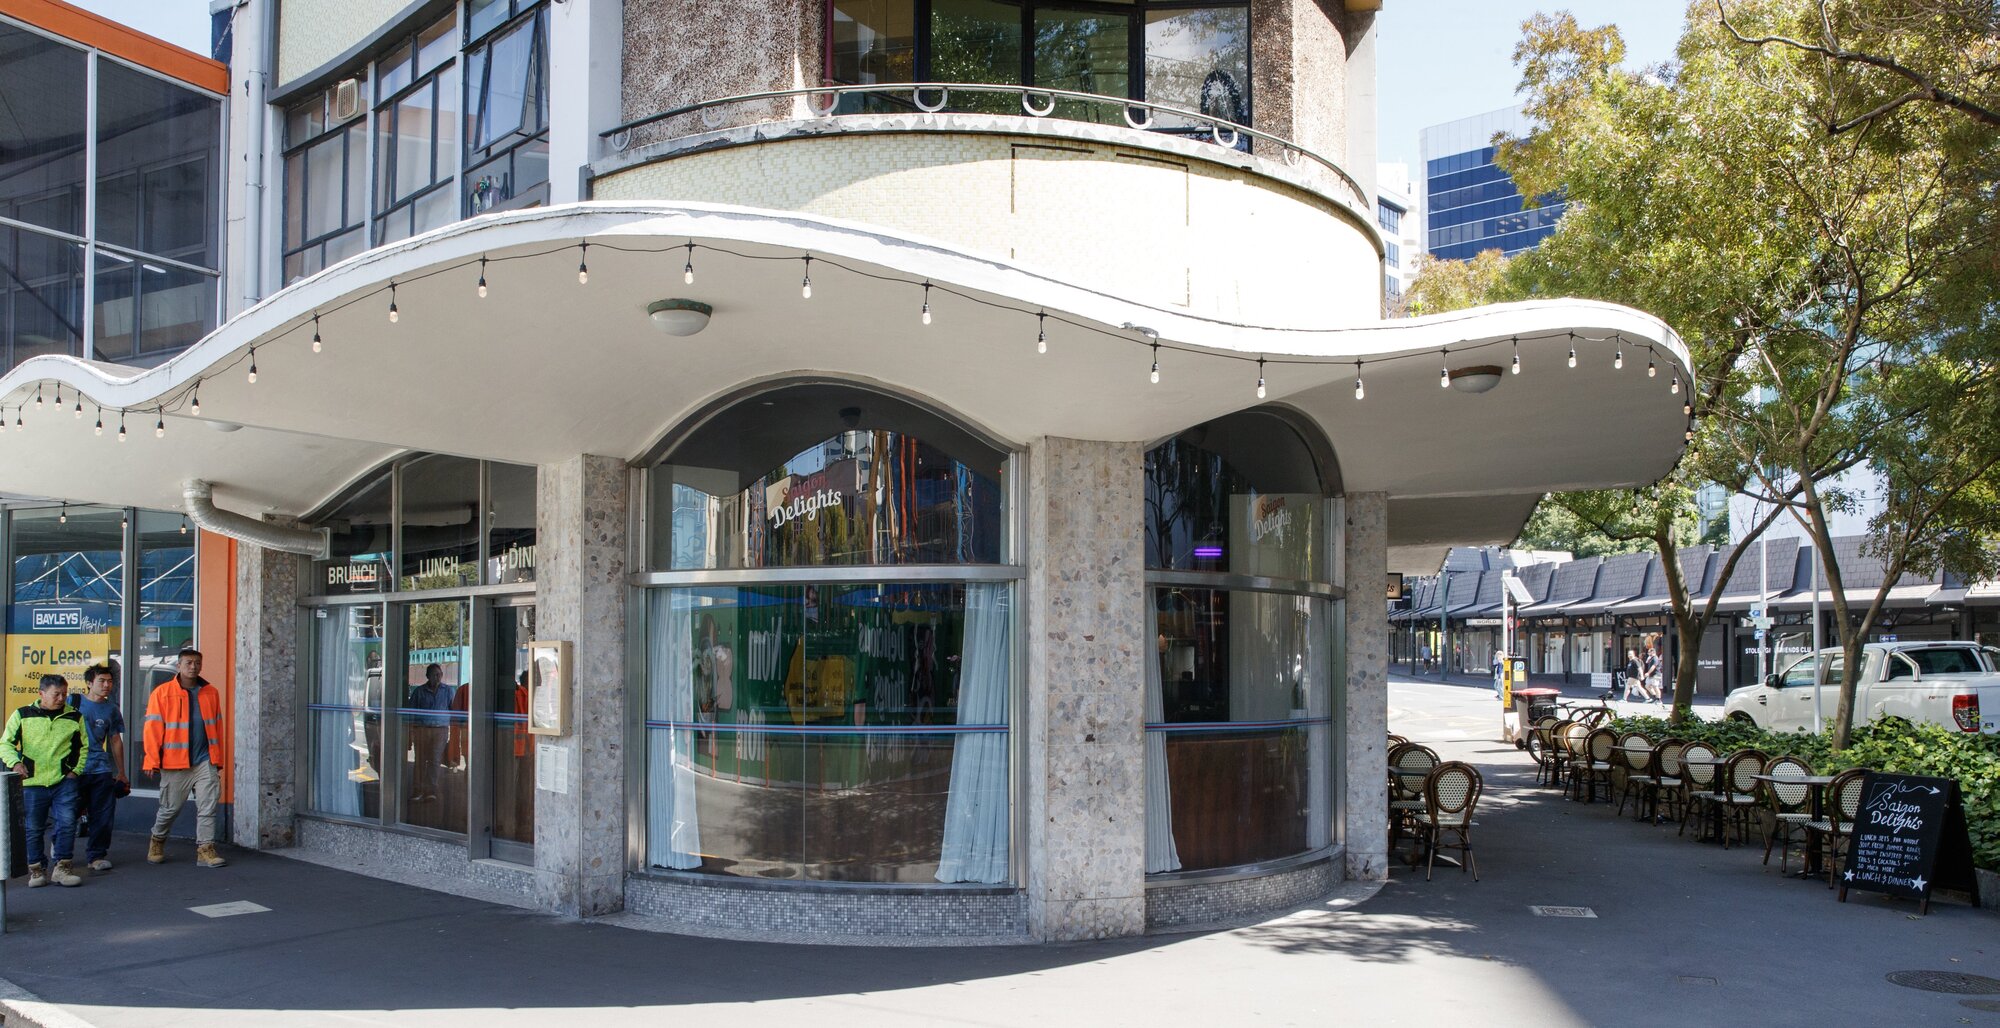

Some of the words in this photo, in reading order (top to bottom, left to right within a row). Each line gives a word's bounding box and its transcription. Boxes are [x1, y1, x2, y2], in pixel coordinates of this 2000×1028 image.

[773, 489, 841, 529] Delights
[1261, 496, 1285, 518] Saigon
[1255, 508, 1292, 541] Delights
[328, 564, 377, 584] BRUNCH
[420, 556, 459, 578] LUNCH
[35, 612, 79, 625] BAYLEYS
[22, 646, 46, 665] For
[50, 646, 92, 665] Lease
[1879, 793, 1921, 814] Saigon
[1871, 811, 1923, 834] Delights
[1856, 872, 1881, 884] LUNCH
[1887, 876, 1914, 888] DINNER
